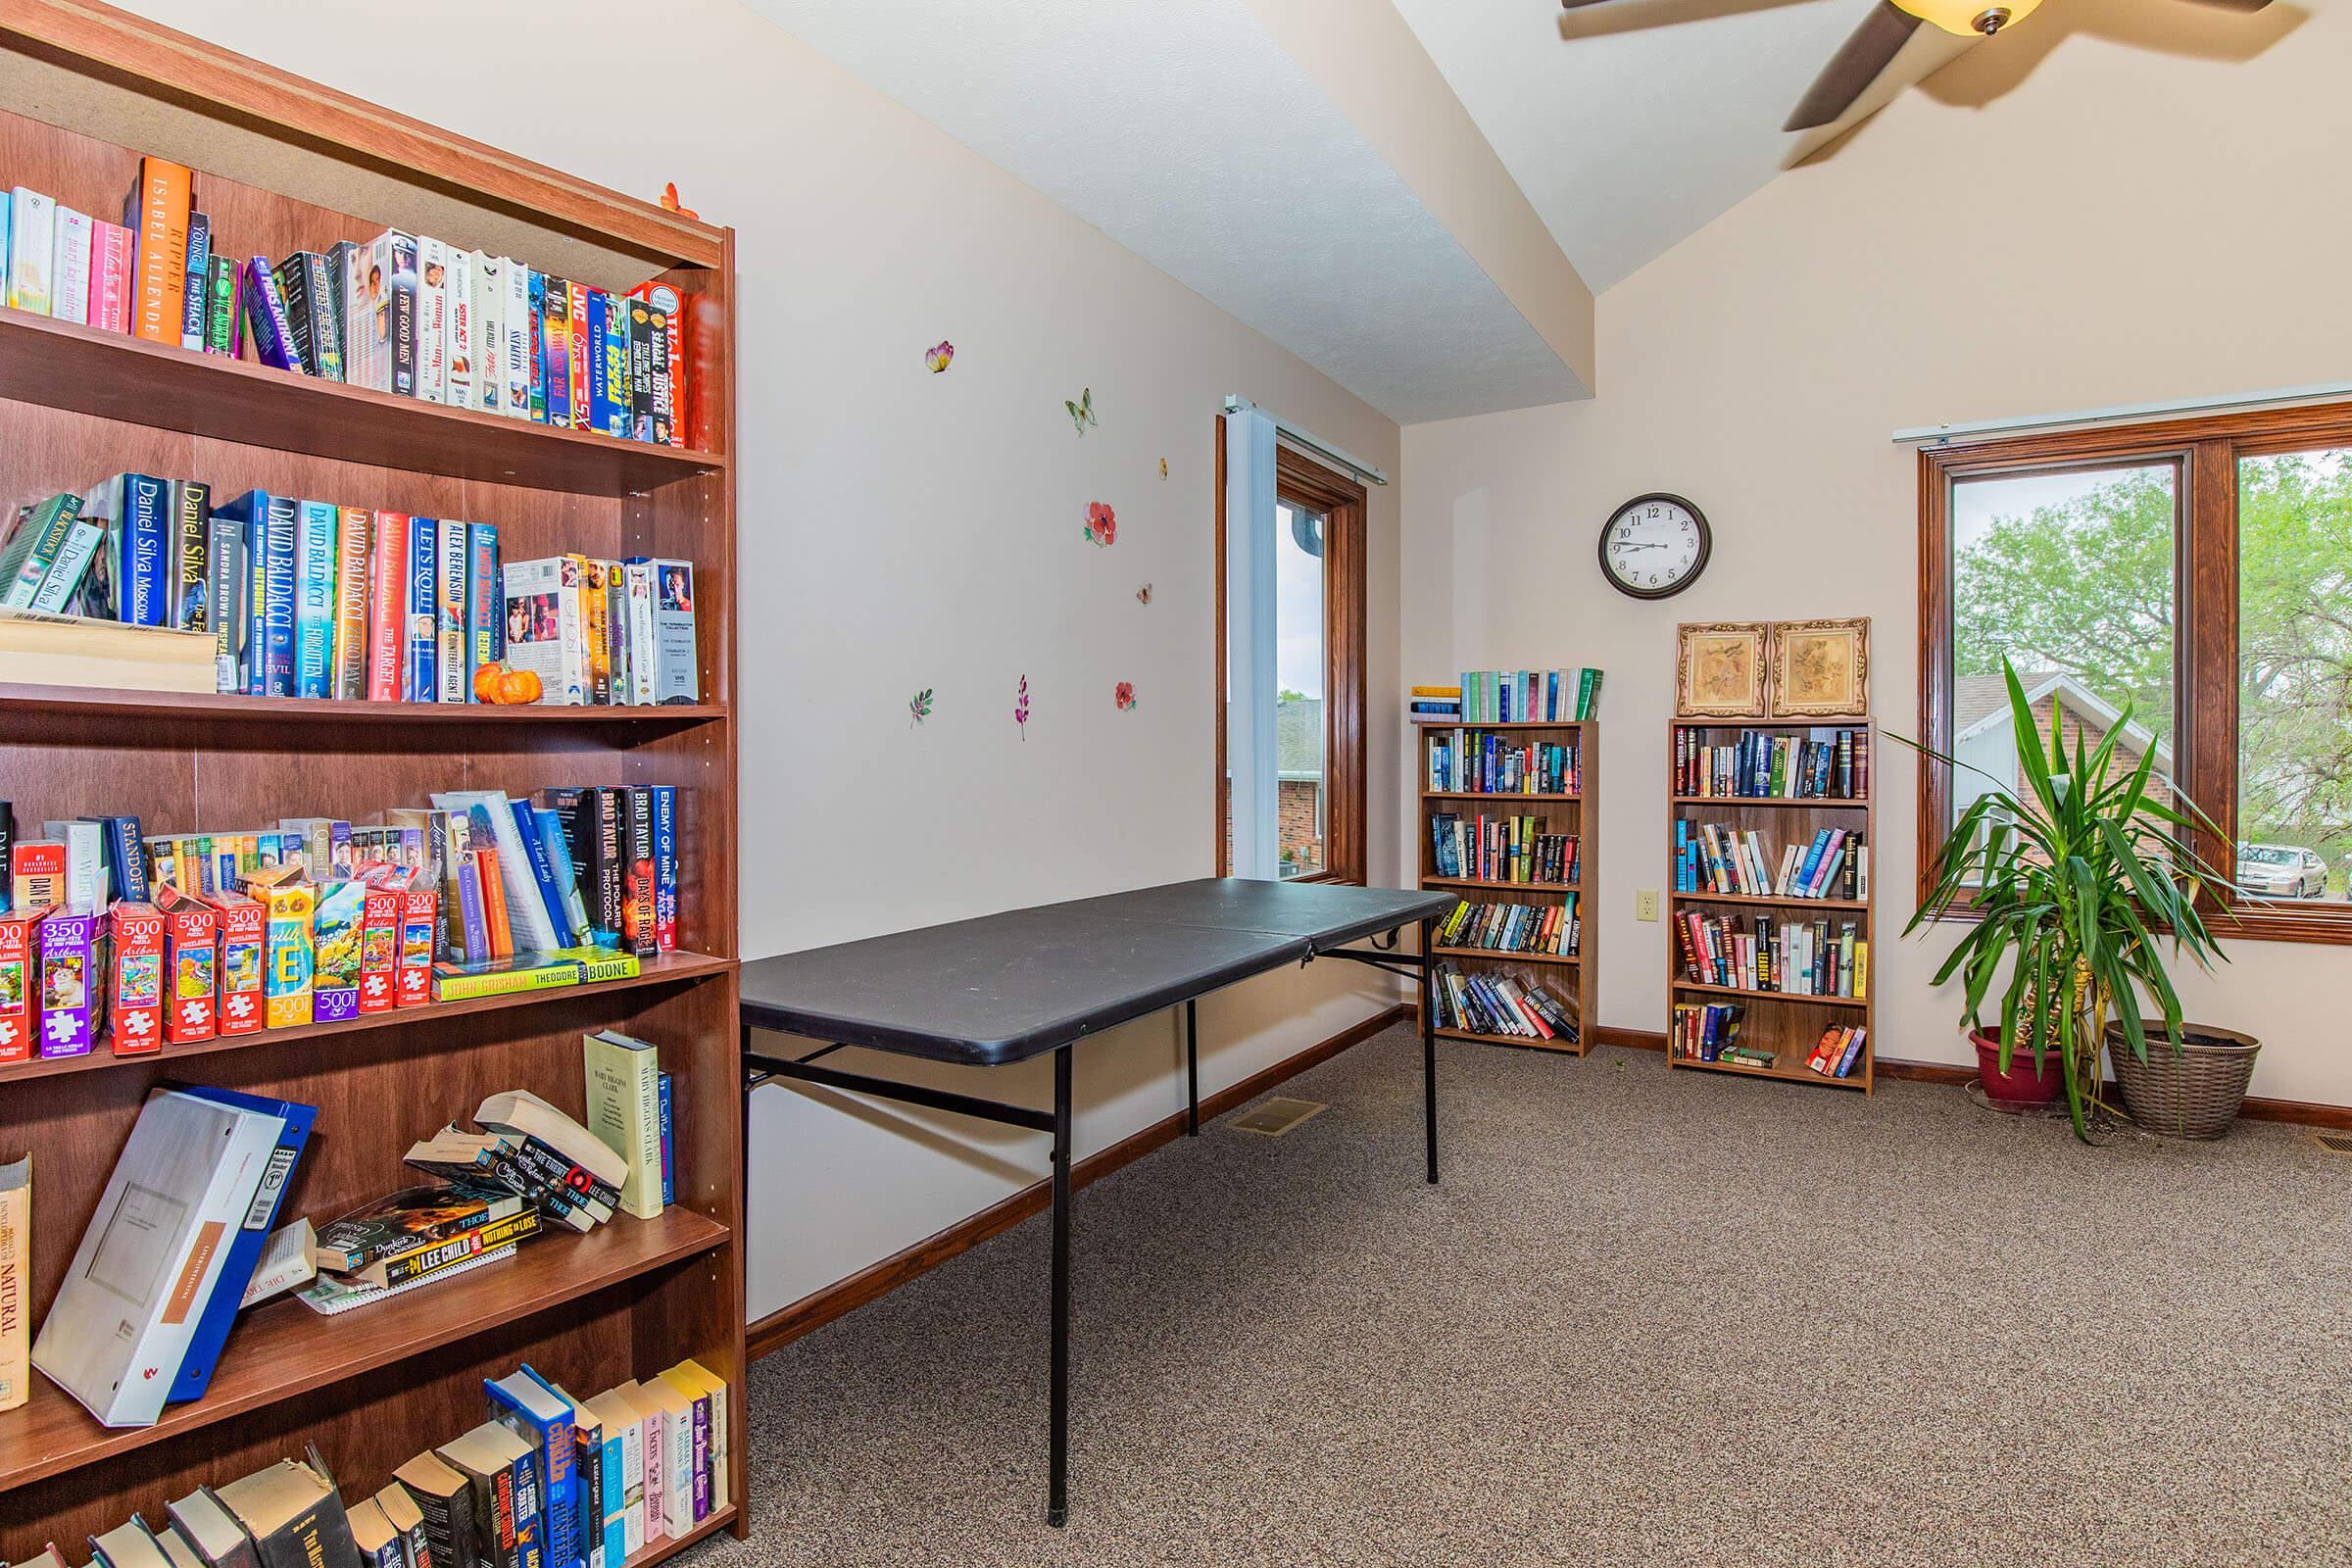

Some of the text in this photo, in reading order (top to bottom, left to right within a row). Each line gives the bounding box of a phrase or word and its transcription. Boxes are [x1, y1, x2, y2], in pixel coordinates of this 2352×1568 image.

[145, 178, 167, 334] ISABEL ALLENDE
[168, 228, 182, 294] RIPPER
[192, 226, 205, 262] YOUNG
[188, 278, 202, 334] THE SHACK
[261, 276, 281, 306] PIERS
[272, 307, 297, 358] ANTHONY
[399, 294, 410, 314] FEW
[572, 286, 585, 321] JVC
[399, 316, 409, 341] GOOD
[432, 295, 443, 368] Man Woman
[399, 344, 409, 365] MEN
[510, 329, 521, 371] SLEEPLESS
[551, 326, 564, 397] FAR AND AWAY
[594, 324, 603, 397] WATERWORLD
[651, 331, 664, 414] SEAGAL JUSTICE
[574, 400, 590, 429] SX
[267, 506, 294, 552] DAVID
[1631, 515, 1641, 525] 11
[1646, 508, 1659, 518] 12
[1669, 510, 1673, 519] 1
[1681, 520, 1688, 531] 2
[182, 487, 205, 583] Daniel Silva
[1613, 545, 1621, 554] 9
[1620, 528, 1631, 538] 10
[1687, 538, 1693, 548] 3
[137, 482, 158, 621] Daniel Silva Moscow
[415, 526, 433, 608] LET'S ROLL!
[449, 525, 464, 603] ALEX BERENSON
[1619, 561, 1626, 570] 8
[1681, 555, 1688, 564] 4
[220, 543, 230, 617] SANDRA BROWN
[477, 547, 492, 627] DAVID BALDACCI
[1633, 571, 1639, 581] 7
[1649, 574, 1657, 584] 6
[1668, 569, 1676, 578] 5
[254, 566, 264, 617] KETOGENIC
[266, 554, 292, 629] BALDACCI
[305, 507, 327, 678] DAVID BALDACCI THE FORGOTTEN
[344, 514, 367, 685] DAVID BALDACCI ZERO DAY
[379, 516, 401, 685] DAVID BALDACCI THE TARGET
[448, 633, 459, 694] COUNTERFEIT AGENT
[601, 792, 617, 859] BRAD TAYLOR
[635, 793, 649, 859] BRAD TAYLOR
[661, 792, 670, 885] ENEMY OF MINE
[122, 822, 145, 899] STANDOFF
[29, 878, 51, 897] DAN
[368, 898, 396, 909] 500
[407, 894, 433, 906] 500
[603, 869, 612, 925] PROTOCOL
[612, 881, 622, 928] POLARIS
[43, 922, 84, 938] 350
[122, 920, 160, 936] 500
[178, 913, 213, 929] 500
[227, 909, 261, 924] 500
[637, 878, 652, 949] DAYS OF RAGE
[277, 947, 299, 982] E
[535, 966, 577, 985] THEODORE
[589, 962, 628, 979] BOONE
[1757, 952, 1769, 982] LEADERS
[319, 993, 352, 1008] 500
[447, 974, 527, 997] JOHN GRISHAM
[641, 1067, 654, 1166] MARY HIGGINS CLARK
[533, 1152, 568, 1178] THE ENEMY
[589, 1184, 615, 1206] LEE CHILD
[482, 1215, 537, 1245] NOTHING LOSE
[421, 1239, 470, 1270] LEE CHILD
[267, 1273, 285, 1289] DIE
[1, 1264, 17, 1338] NATURAL
[548, 1422, 565, 1484] CUSSLER
[649, 1429, 661, 1460] FACETS
[497, 1472, 514, 1551] CATHERINE COULTER
[516, 1489, 527, 1523] COULTER
[526, 1483, 536, 1517] CATHERINE
[552, 1501, 567, 1568] HUNTERS
